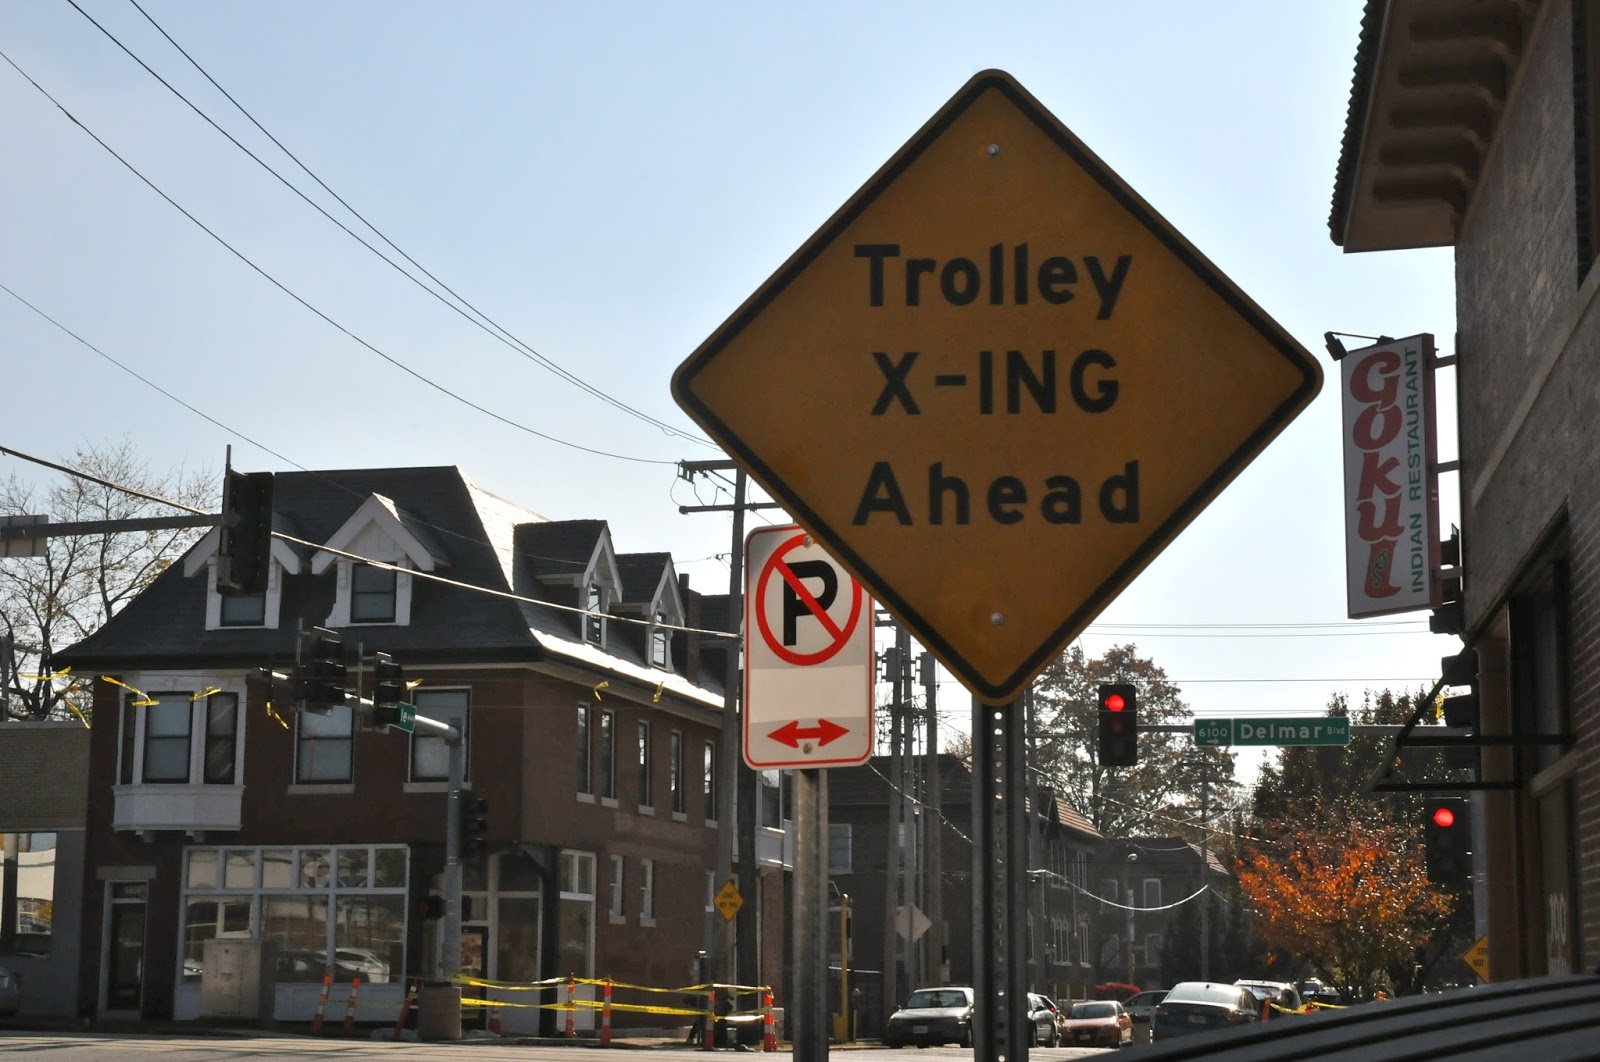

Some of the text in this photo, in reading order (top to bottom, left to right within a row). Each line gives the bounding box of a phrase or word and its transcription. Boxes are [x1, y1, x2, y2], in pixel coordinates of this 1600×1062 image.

[854, 243, 1132, 320] Trolley
[871, 350, 1119, 416] X-ING
[852, 460, 1140, 526] Ahead
[1405, 347, 1424, 593] INDIAN RESTAURANT
[1198, 727, 1228, 738] 6100
[1240, 724, 1345, 739] Delmar Blvd
